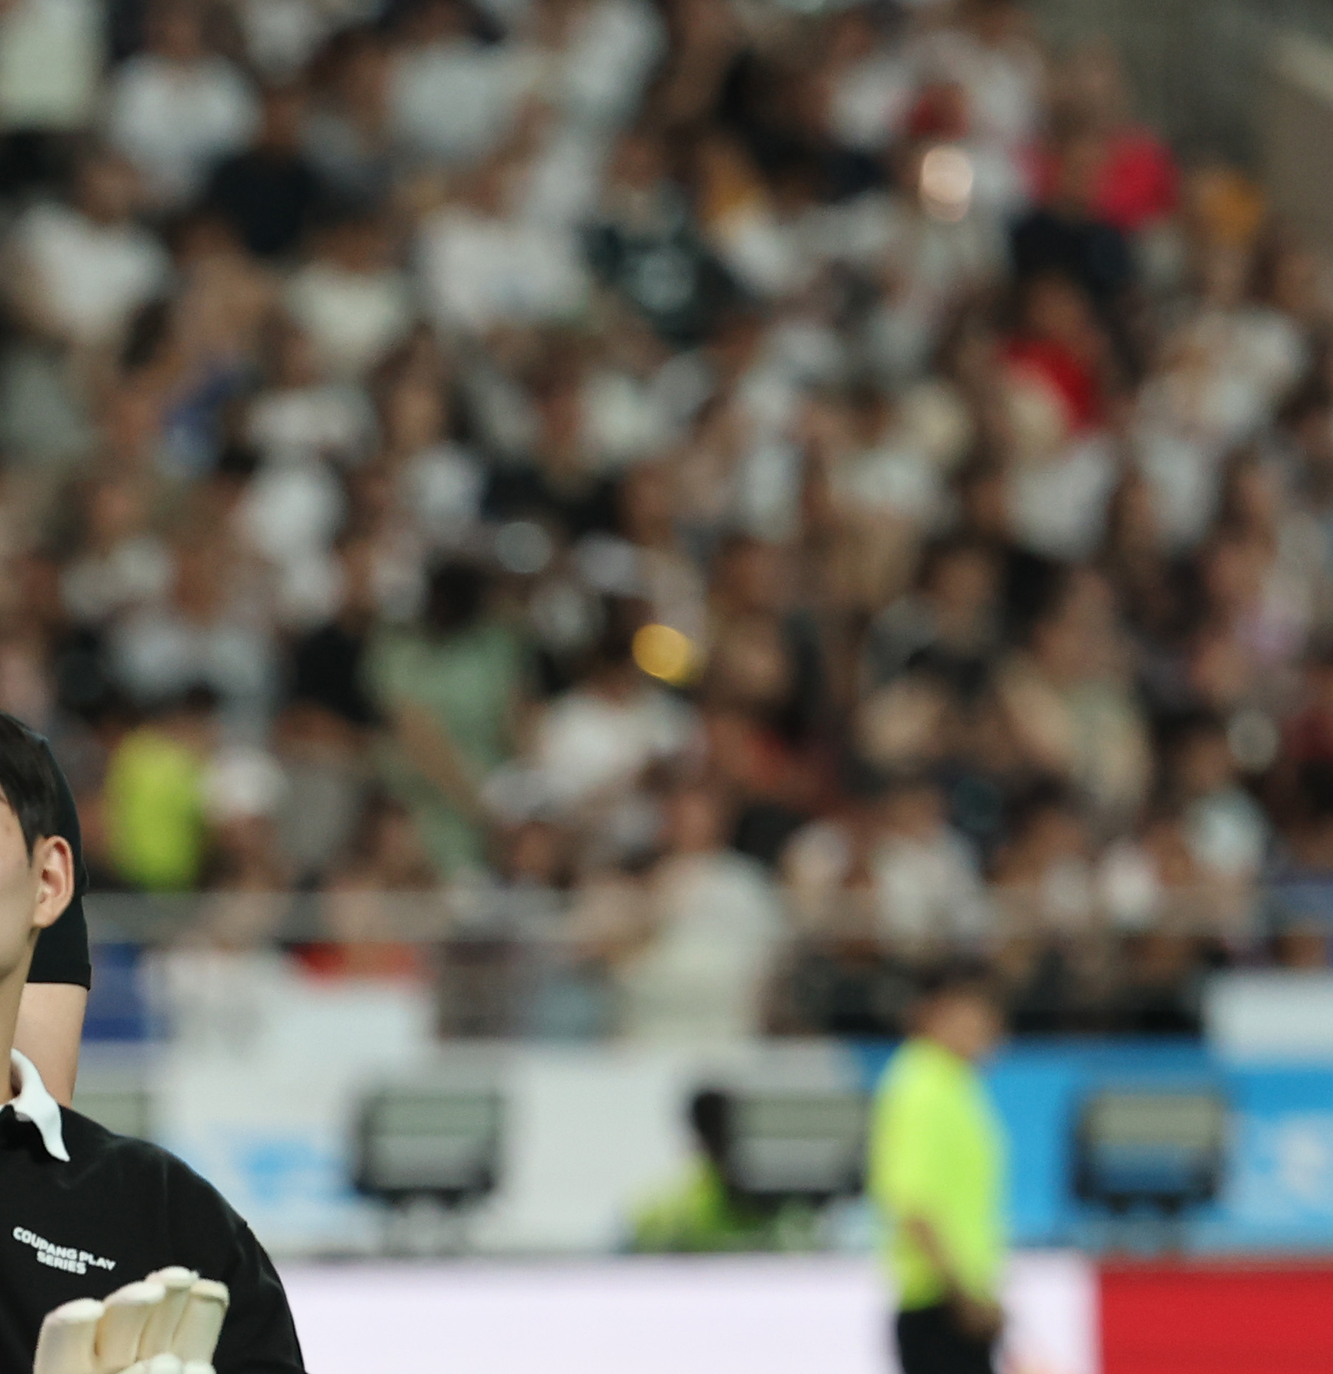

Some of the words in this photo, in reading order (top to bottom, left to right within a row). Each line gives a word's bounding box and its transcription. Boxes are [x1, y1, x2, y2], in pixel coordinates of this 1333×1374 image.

[13, 1227, 77, 1259] COUPANG
[79, 1251, 116, 1271] PLAY
[37, 1251, 86, 1274] SERIES
